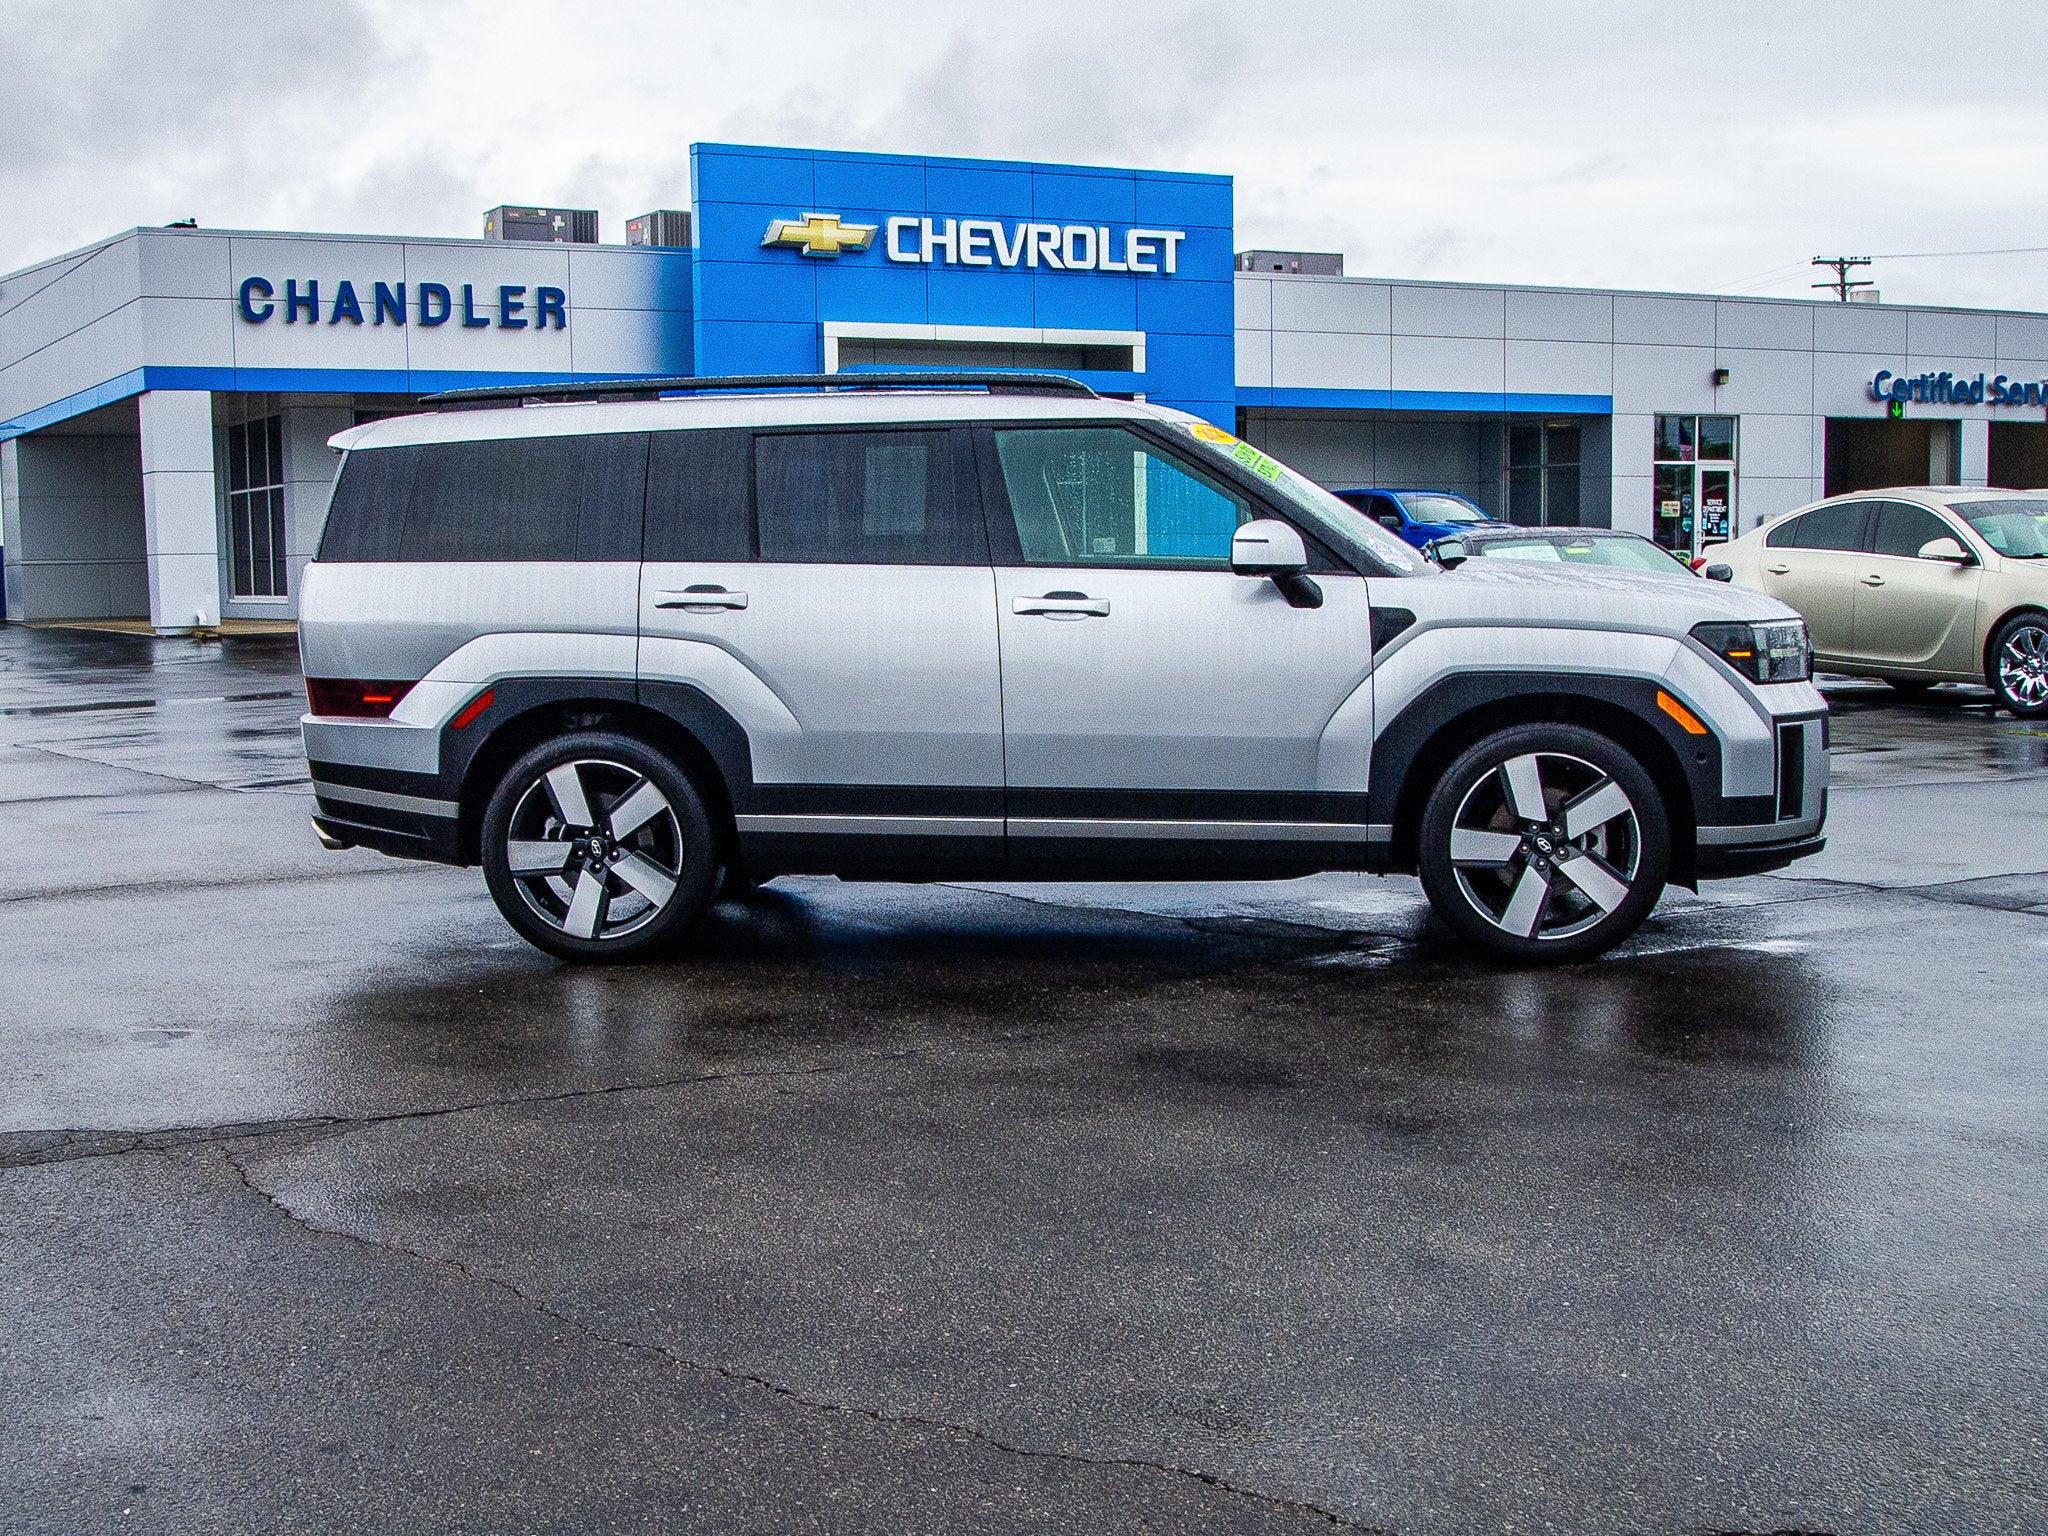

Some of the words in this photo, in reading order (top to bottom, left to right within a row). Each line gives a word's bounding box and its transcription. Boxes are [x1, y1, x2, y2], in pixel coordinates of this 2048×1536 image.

[884, 215, 1186, 275] CHEVROLET
[238, 275, 567, 330] CHANDLER
[1873, 369, 1985, 404] Certified
